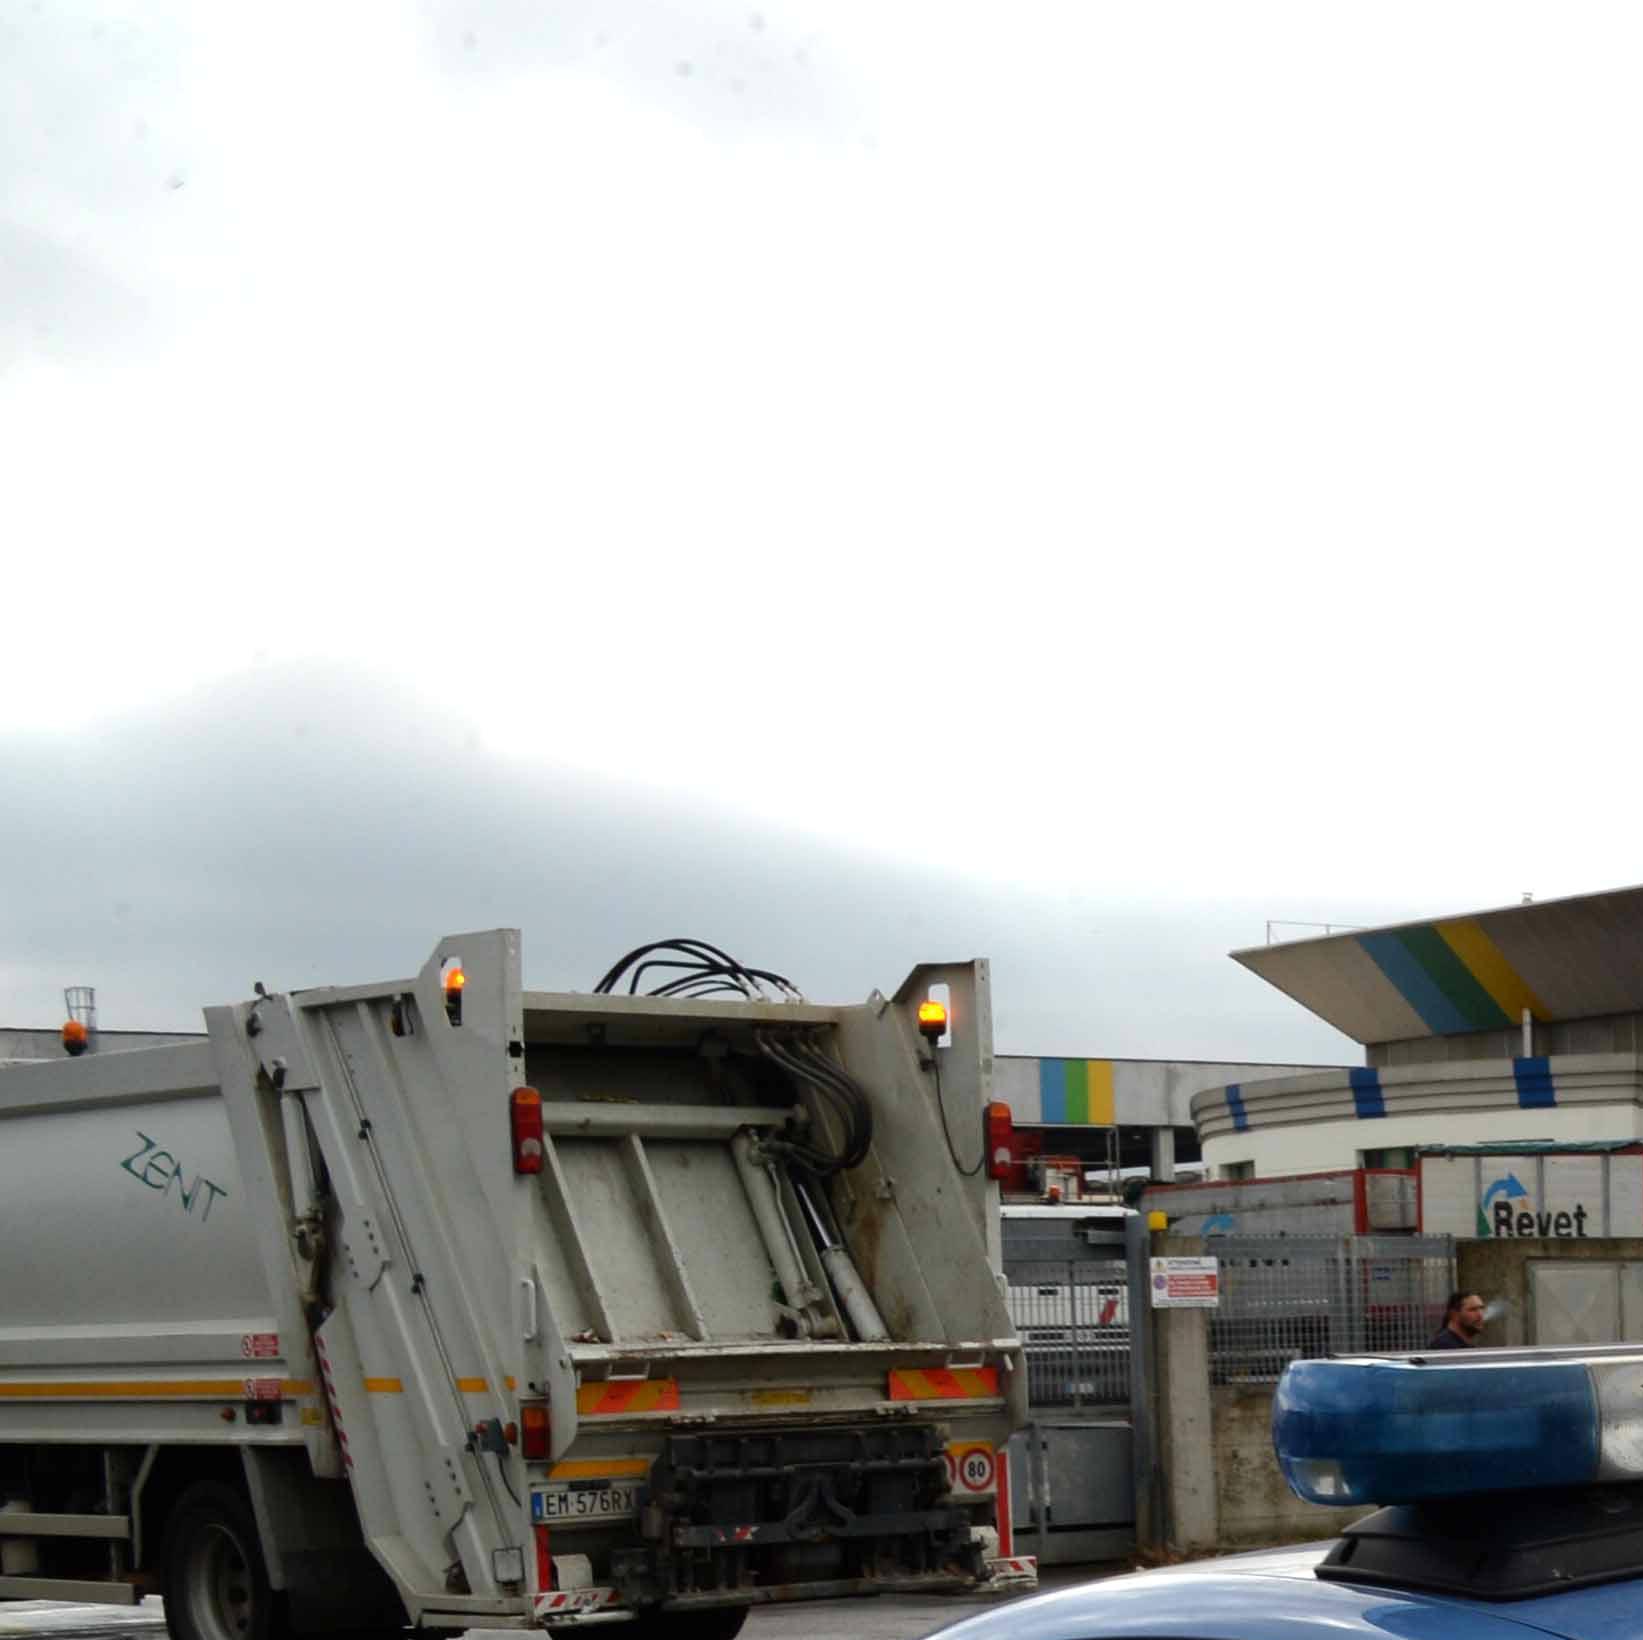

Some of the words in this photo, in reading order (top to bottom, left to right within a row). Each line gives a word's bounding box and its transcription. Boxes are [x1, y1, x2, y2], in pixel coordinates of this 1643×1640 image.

[120, 1130, 228, 1223] ZENIT
[1493, 1200, 1588, 1238] Revet
[967, 1460, 987, 1479] 80
